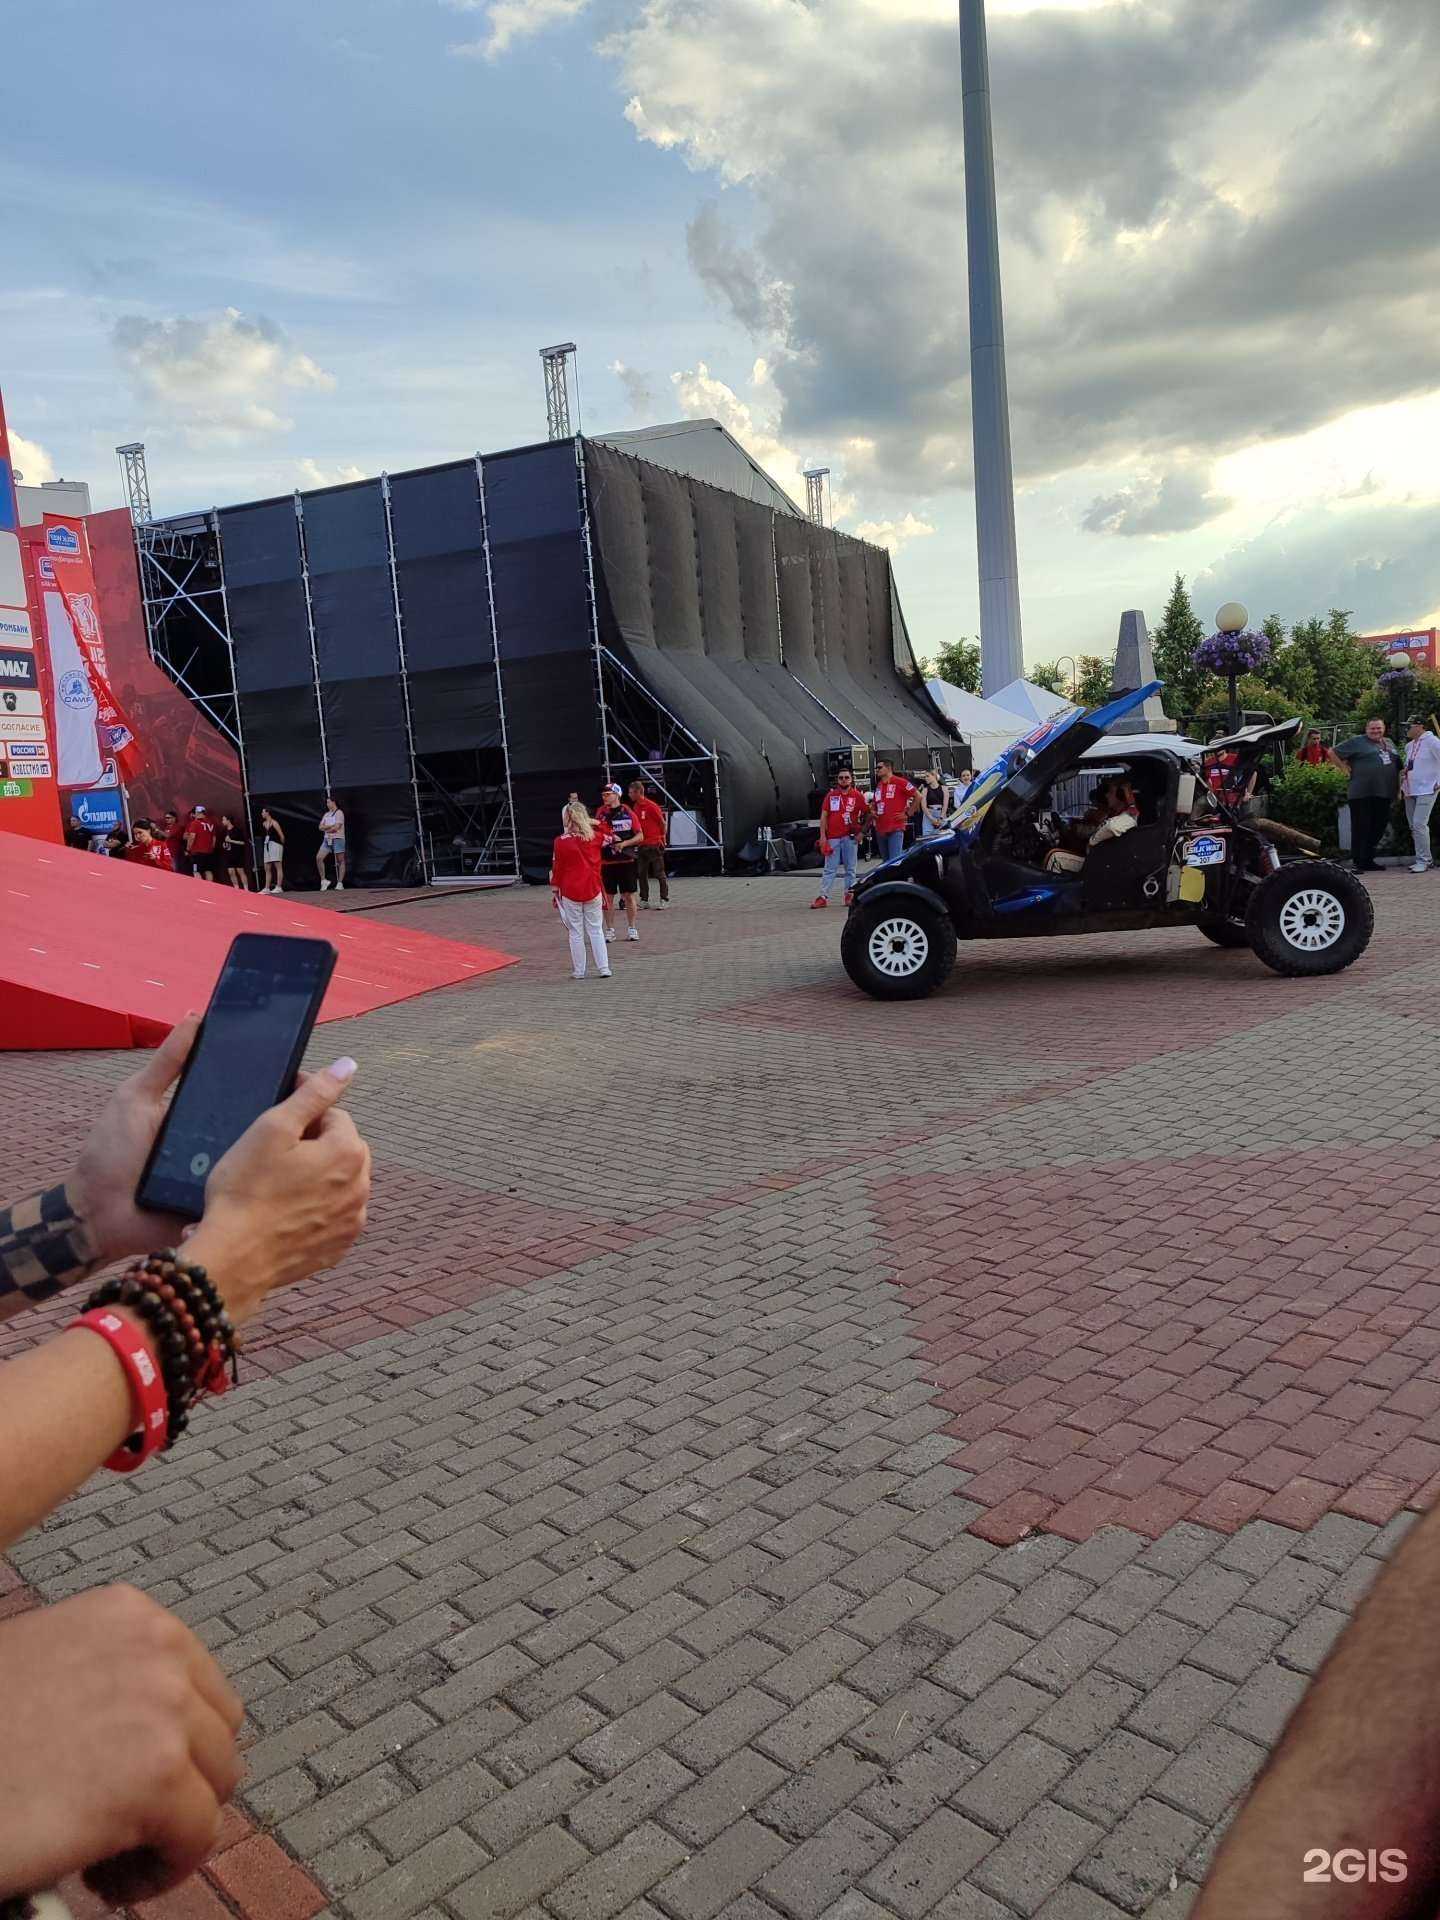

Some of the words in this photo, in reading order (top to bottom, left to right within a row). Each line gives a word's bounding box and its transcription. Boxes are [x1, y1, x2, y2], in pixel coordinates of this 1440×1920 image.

[12, 746, 36, 755] РОССИЯ
[201, 822, 214, 833] TV
[1187, 846, 1205, 854] SILK
